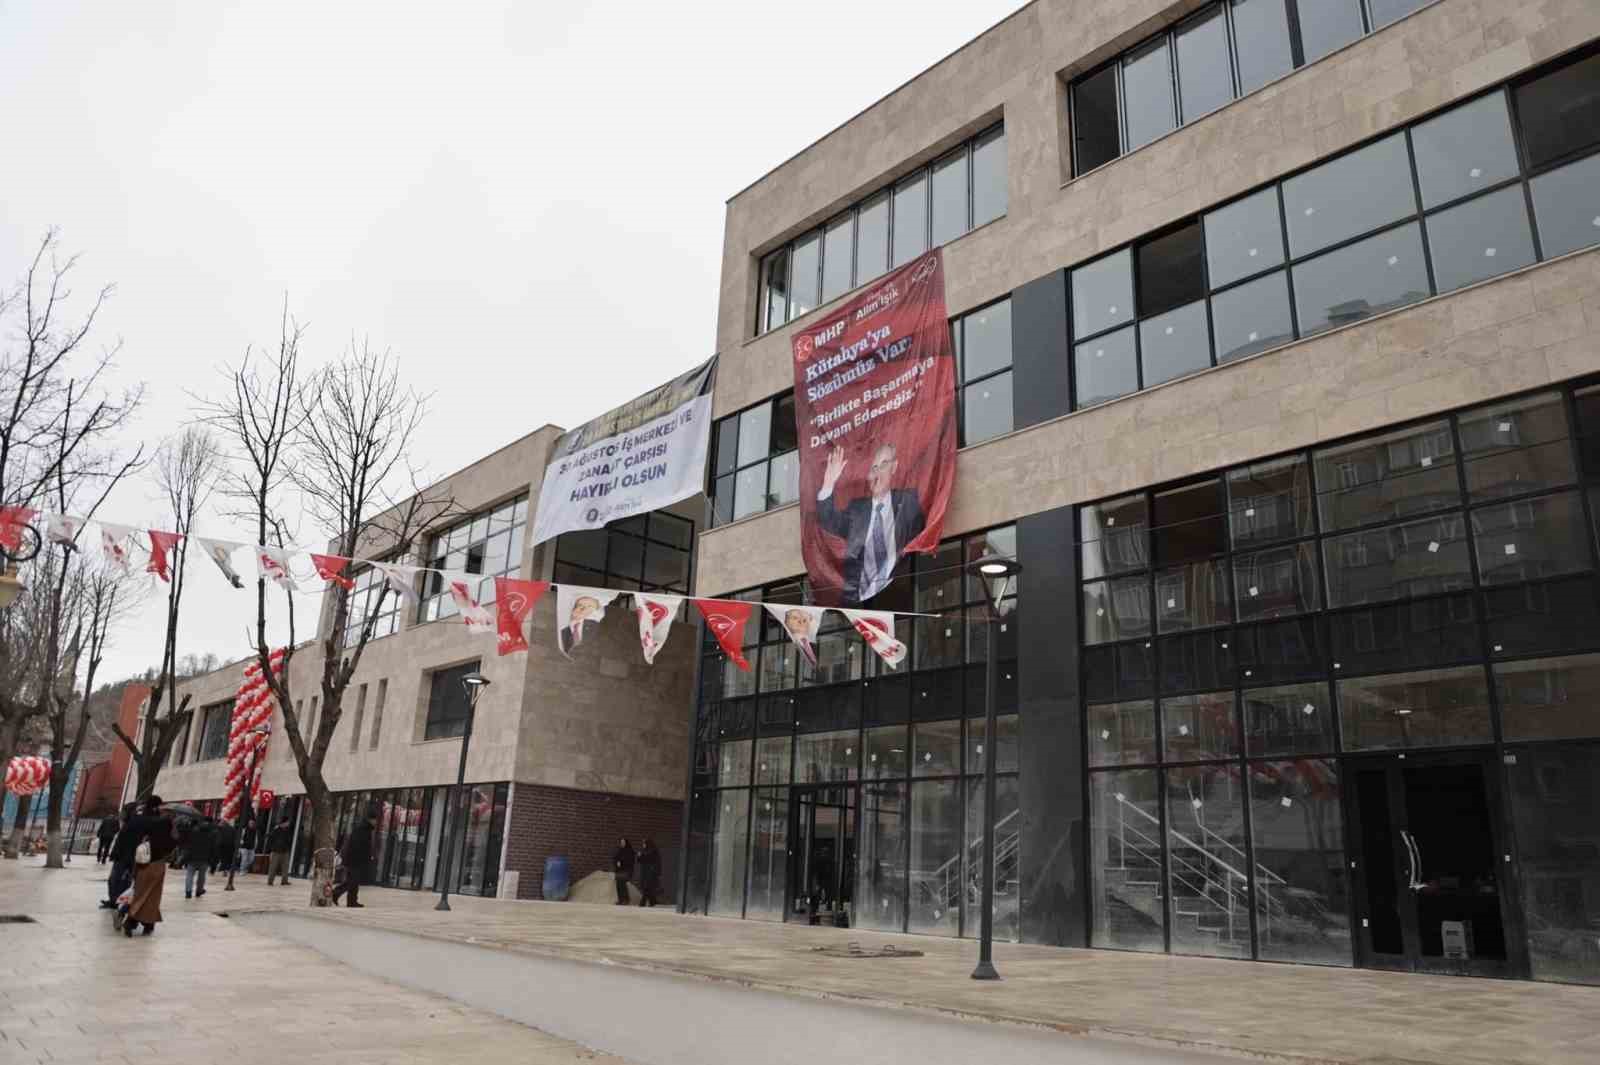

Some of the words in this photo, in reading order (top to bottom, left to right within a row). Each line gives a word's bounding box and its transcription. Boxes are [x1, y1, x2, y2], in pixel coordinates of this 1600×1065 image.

[814, 321, 845, 348] MHP
[807, 358, 876, 402] Sözümüz
[863, 356, 934, 404] Başarmaya
[680, 409, 692, 425] VE
[810, 422, 852, 448] Devam
[621, 463, 667, 488] OLSUN
